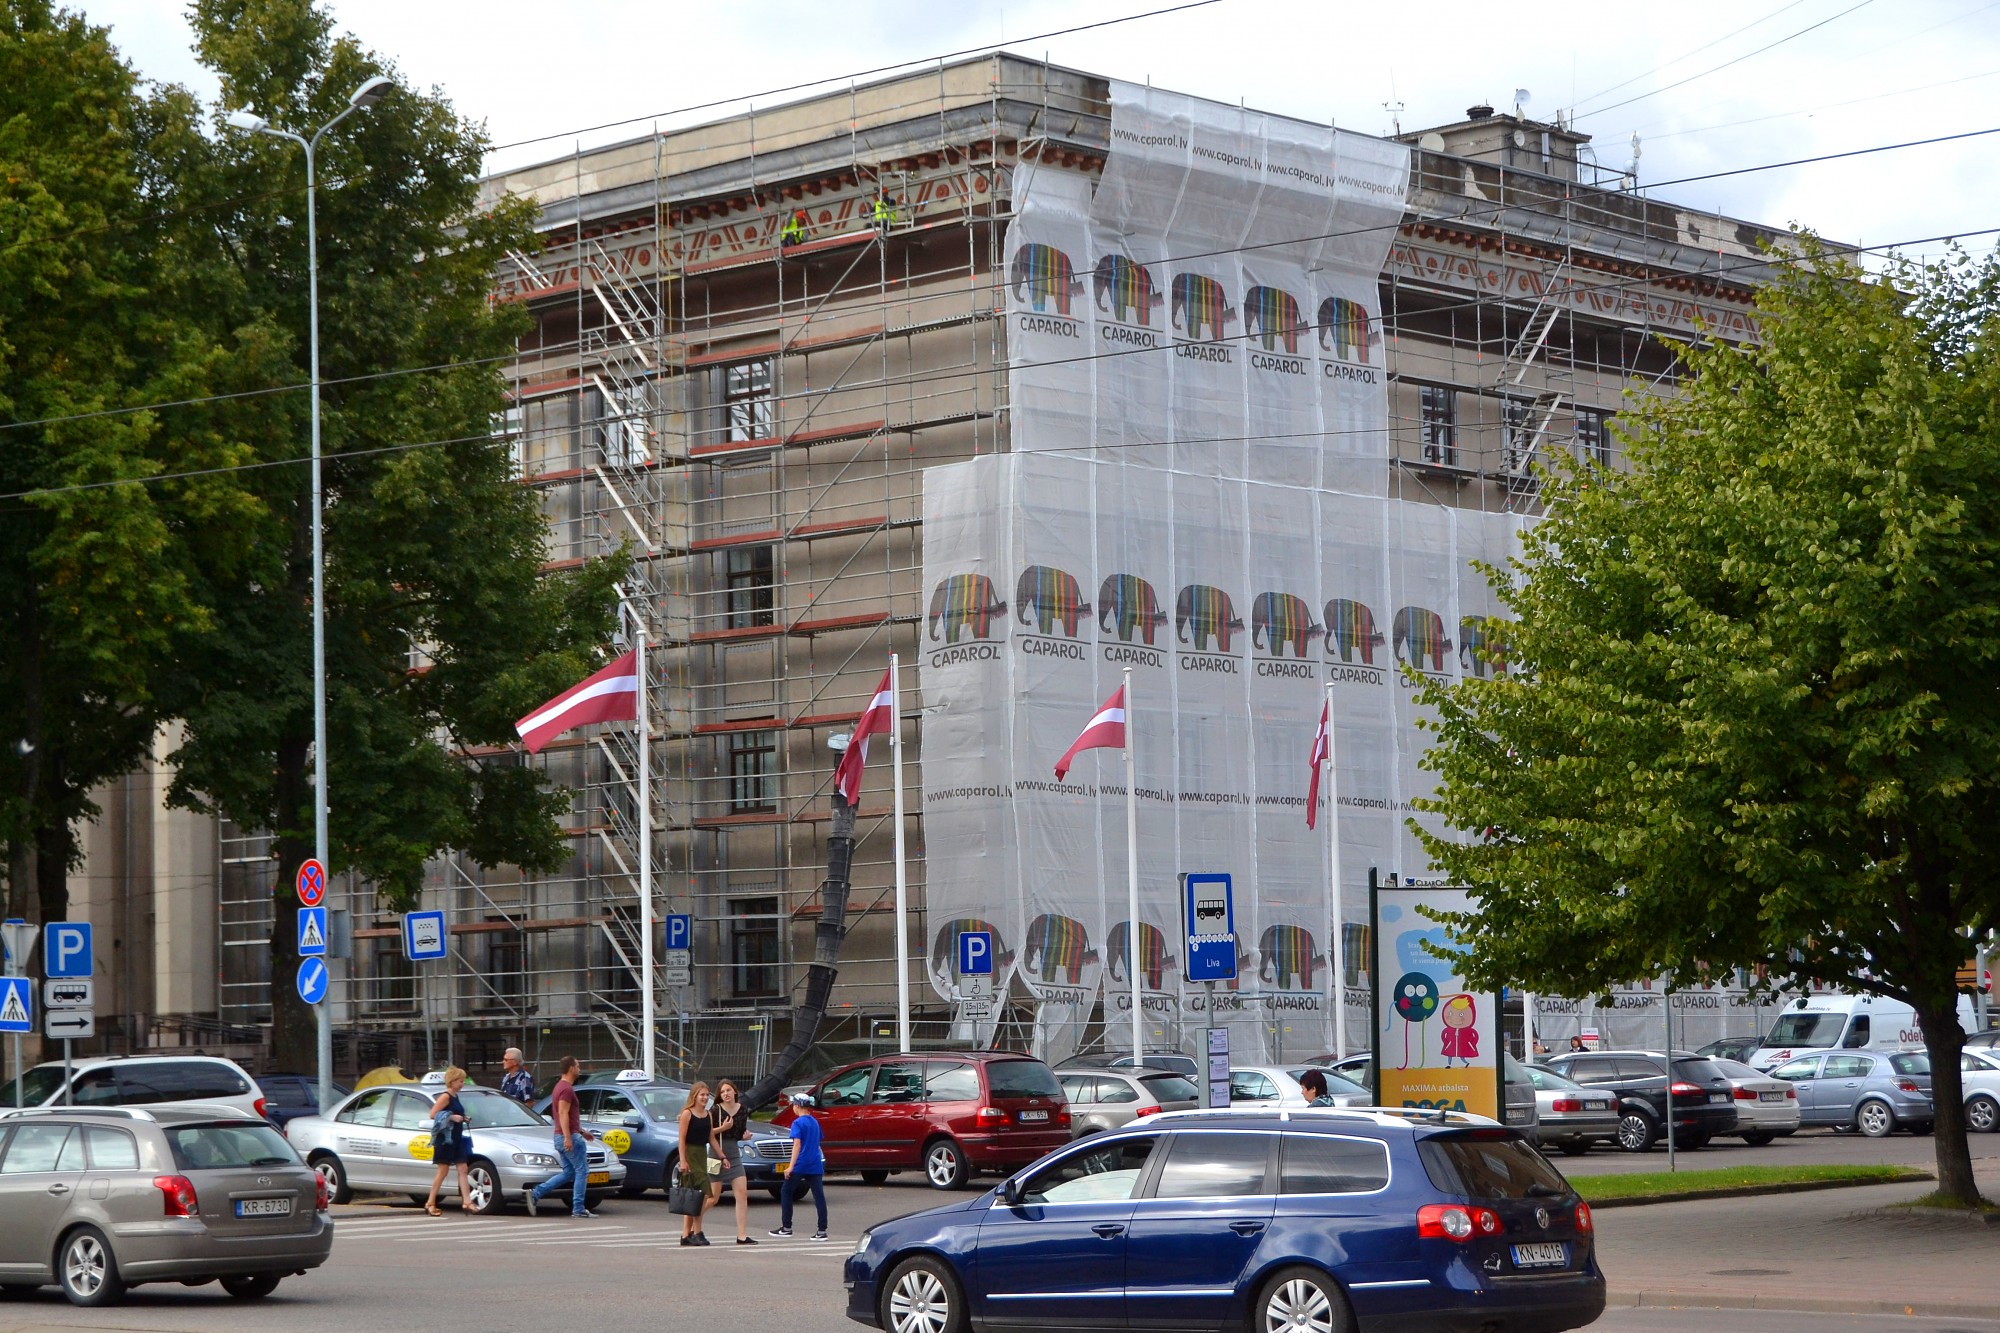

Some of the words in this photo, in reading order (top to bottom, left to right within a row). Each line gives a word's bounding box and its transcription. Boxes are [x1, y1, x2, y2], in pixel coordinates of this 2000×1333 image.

[1020, 316, 1080, 339] CAPAROL
[1102, 325, 1159, 348] CAPAROL
[1175, 342, 1233, 364] CAPAROL
[1251, 354, 1307, 375] CAPAROL
[1324, 363, 1378, 385] CAPAROL
[931, 645, 1001, 669] CAPAROL
[1022, 638, 1086, 661] CAPAROL
[1104, 646, 1163, 668] CAPAROL
[1181, 655, 1238, 674] CAPAROL
[1257, 662, 1314, 679] CAPAROL
[1330, 667, 1383, 686] CAPAROL
[927, 784, 1013, 803] www.caparol.lv
[1015, 780, 1097, 798] www.caparol.lv
[1099, 784, 1174, 803] www.aparol.lv
[671, 918, 685, 946] P
[58, 929, 84, 972] P
[967, 937, 987, 970] P
[1539, 1000, 1583, 1014] CAPAROL
[1672, 994, 1720, 1009] CAPAROL
[1402, 1084, 1437, 1092] MAXIMA
[1438, 1083, 1469, 1092] atbalsta
[243, 1200, 288, 1214] KR-6730
[1517, 1244, 1563, 1262] KN-4016
